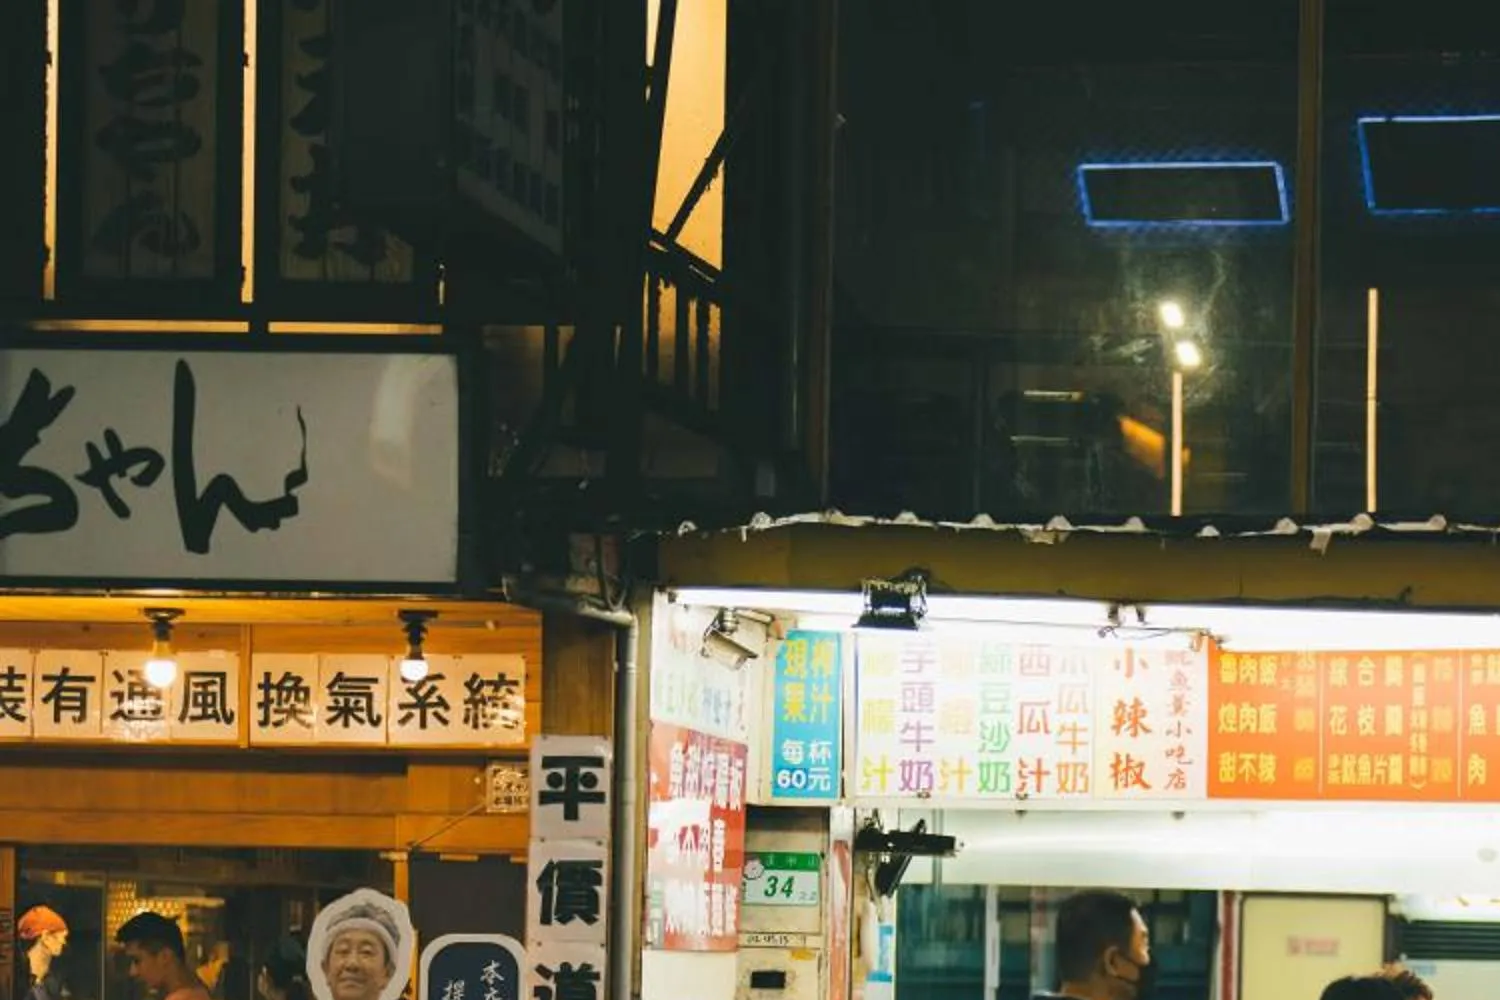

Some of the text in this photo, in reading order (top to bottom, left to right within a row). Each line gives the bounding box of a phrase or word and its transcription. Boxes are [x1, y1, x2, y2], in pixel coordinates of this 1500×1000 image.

[1016, 643, 1052, 793] 西瓜汁
[1110, 647, 1152, 791] 小辣椒
[782, 739, 832, 765] 每杯
[777, 767, 832, 791] 60元
[1218, 752, 1277, 784] 甜不辣
[764, 875, 794, 898] 34
